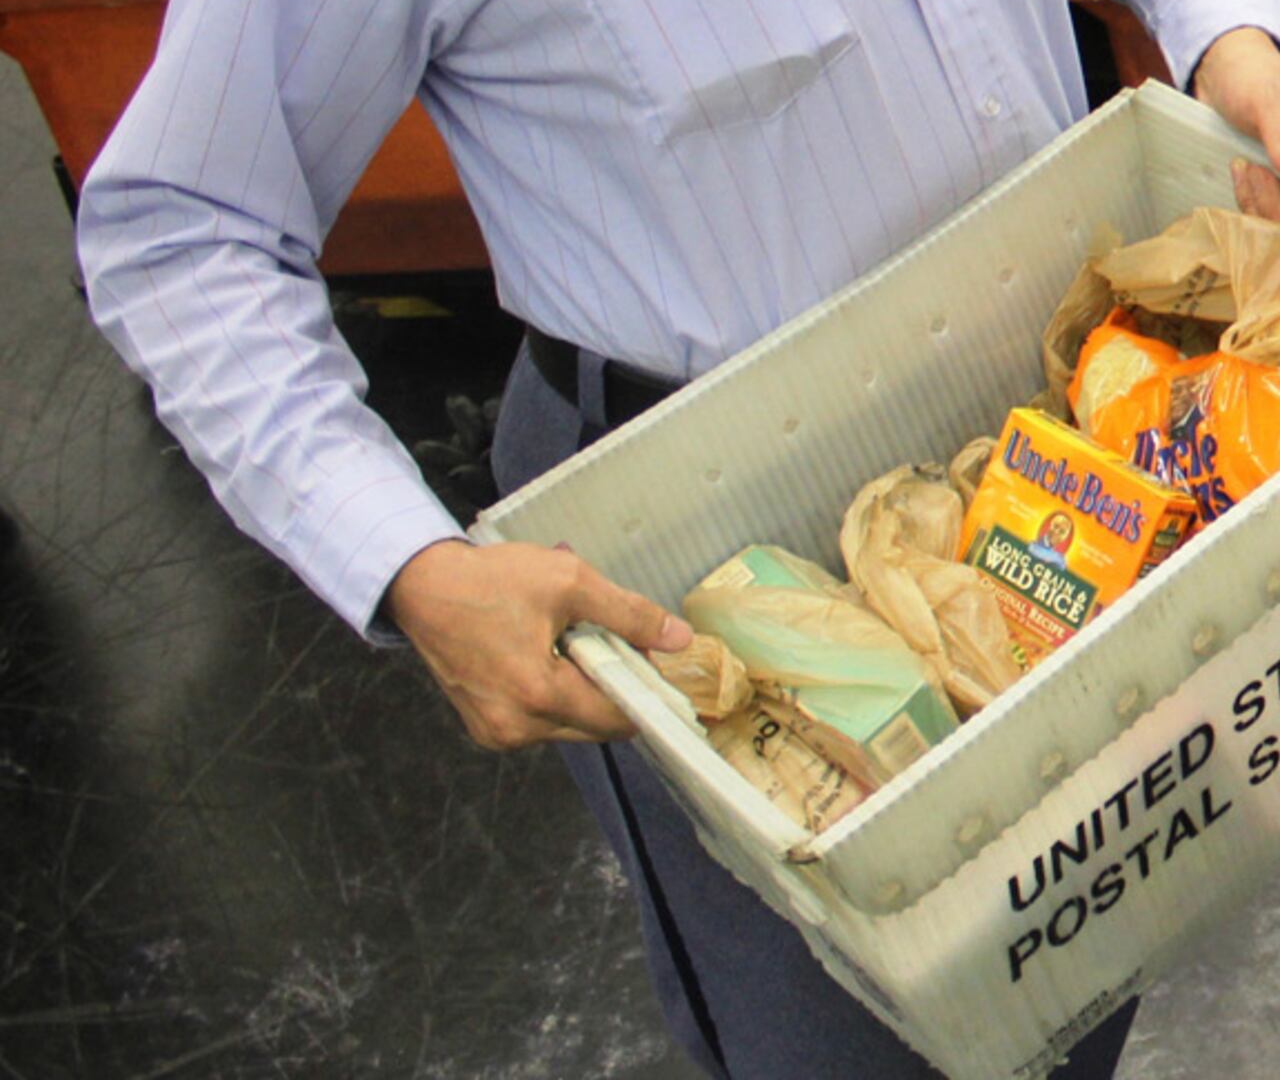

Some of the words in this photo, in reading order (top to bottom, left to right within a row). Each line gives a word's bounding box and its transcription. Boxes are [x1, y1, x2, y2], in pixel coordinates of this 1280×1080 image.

[1003, 429, 1080, 502] Uncle
[1077, 473, 1148, 543] Ben's
[1134, 406, 1217, 487] Uncle
[984, 546, 1034, 590] WILD
[1034, 583, 1086, 624] RICE
[993, 536, 1031, 566] LONG
[1034, 564, 1076, 600] GRAIN
[1078, 590, 1087, 604] &
[1030, 606, 1067, 637] RECIPE
[1007, 718, 1218, 915] UNITED
[1007, 788, 1234, 982] POSTAL
